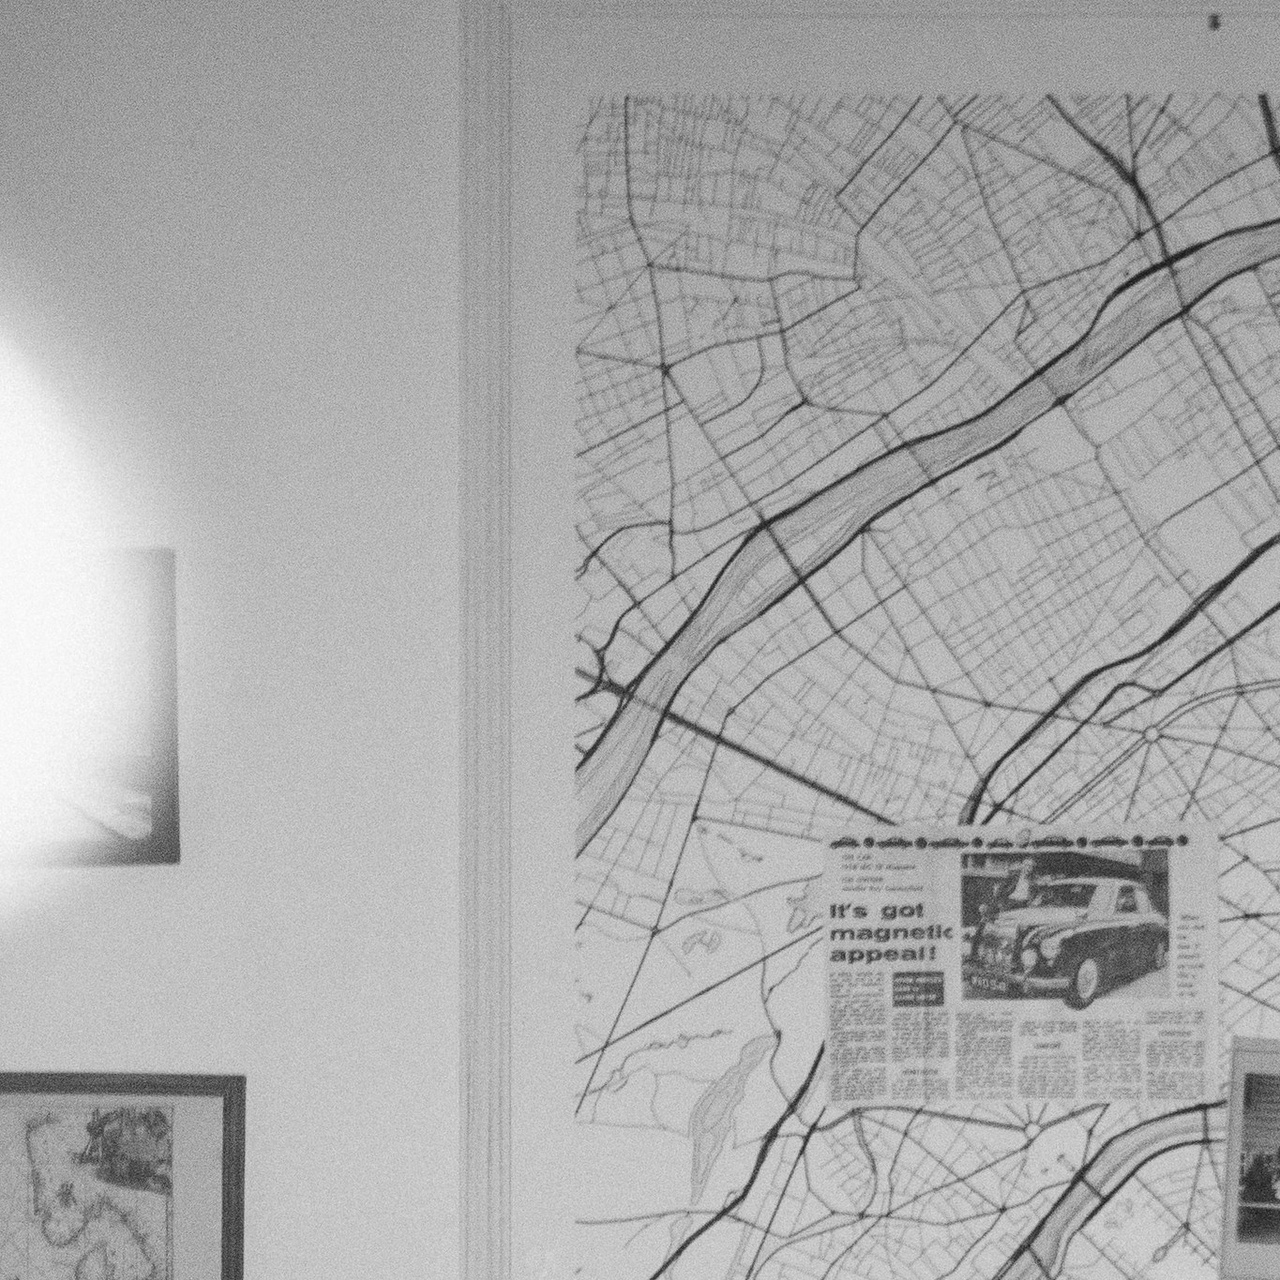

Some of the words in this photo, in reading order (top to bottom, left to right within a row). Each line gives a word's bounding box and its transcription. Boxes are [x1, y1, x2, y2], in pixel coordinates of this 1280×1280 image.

[829, 903, 868, 919] It's
[880, 902, 925, 921] got
[829, 924, 954, 943] magnetic
[829, 945, 937, 965] appeal!
